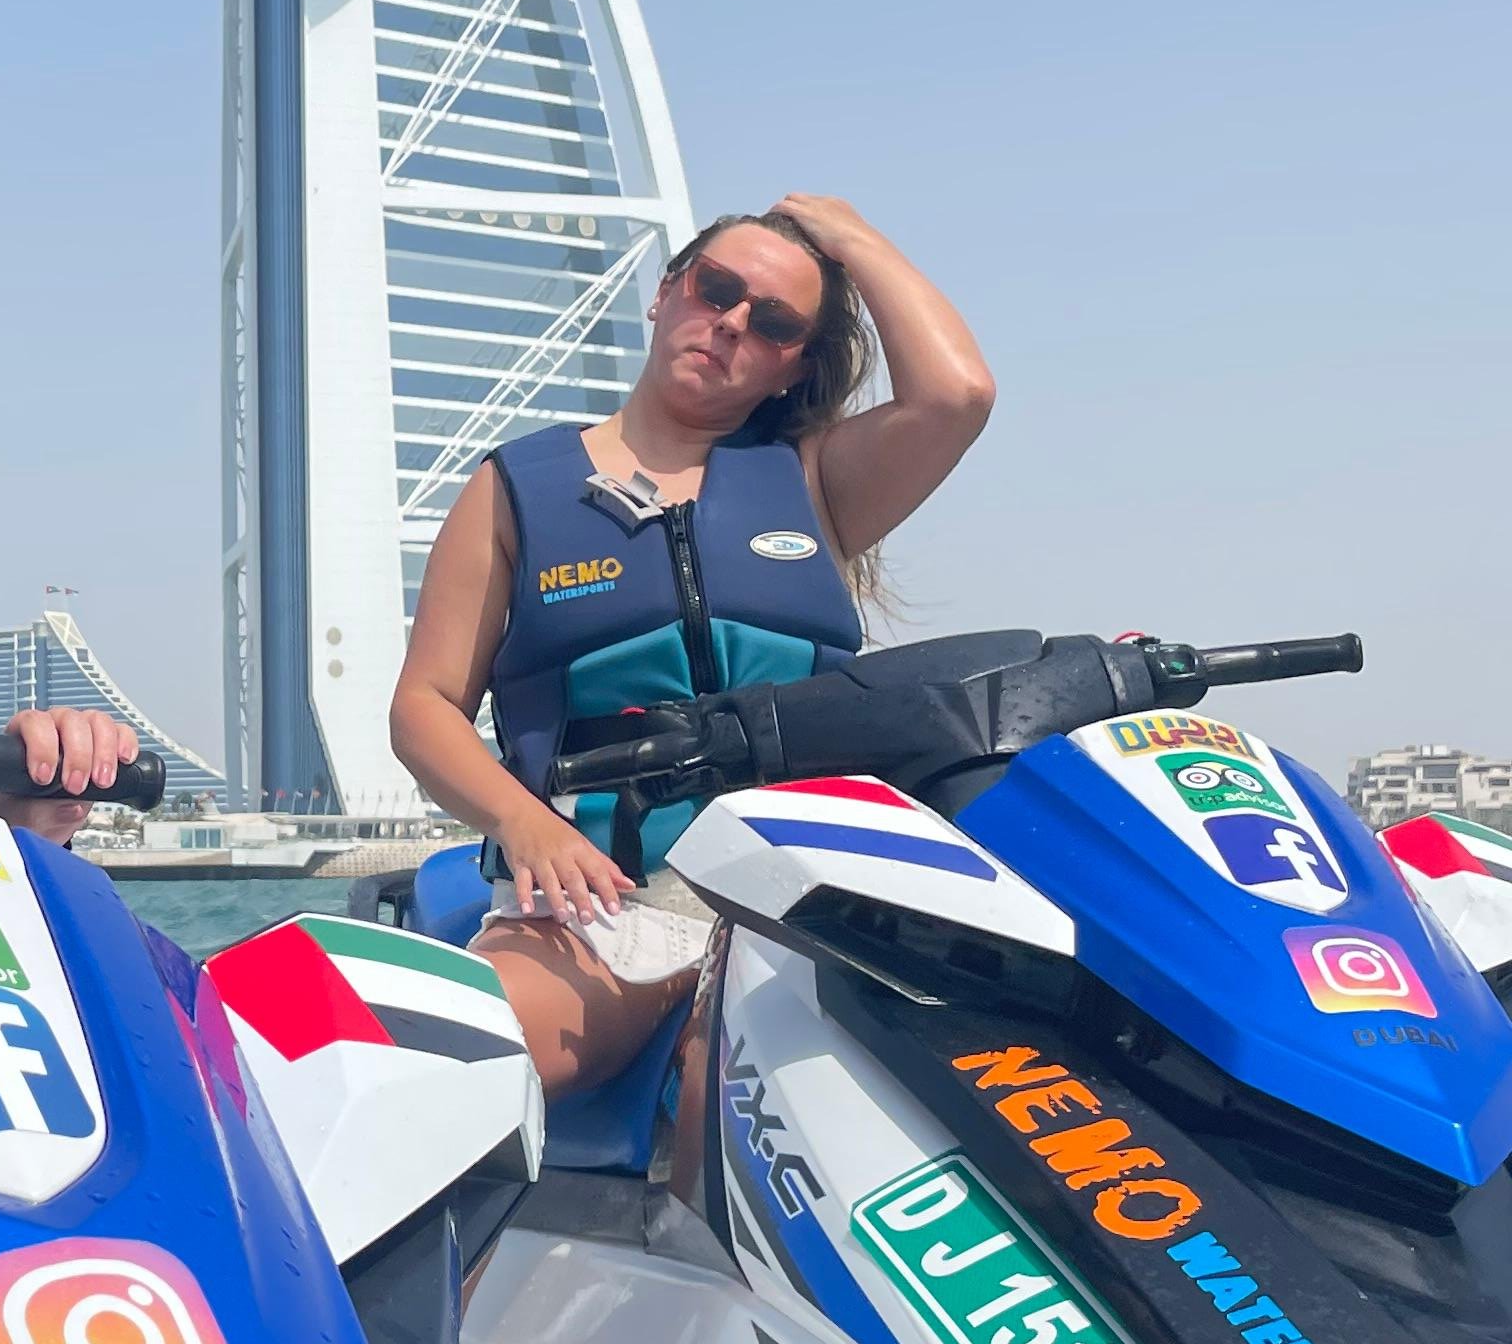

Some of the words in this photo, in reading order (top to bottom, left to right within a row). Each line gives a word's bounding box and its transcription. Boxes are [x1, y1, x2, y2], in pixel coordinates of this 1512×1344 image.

[539, 557, 624, 592] NEMO
[542, 580, 616, 606] WATERSPORTS
[1352, 1028, 1458, 1053] DUBAI
[951, 1045, 1204, 1241] NEMO
